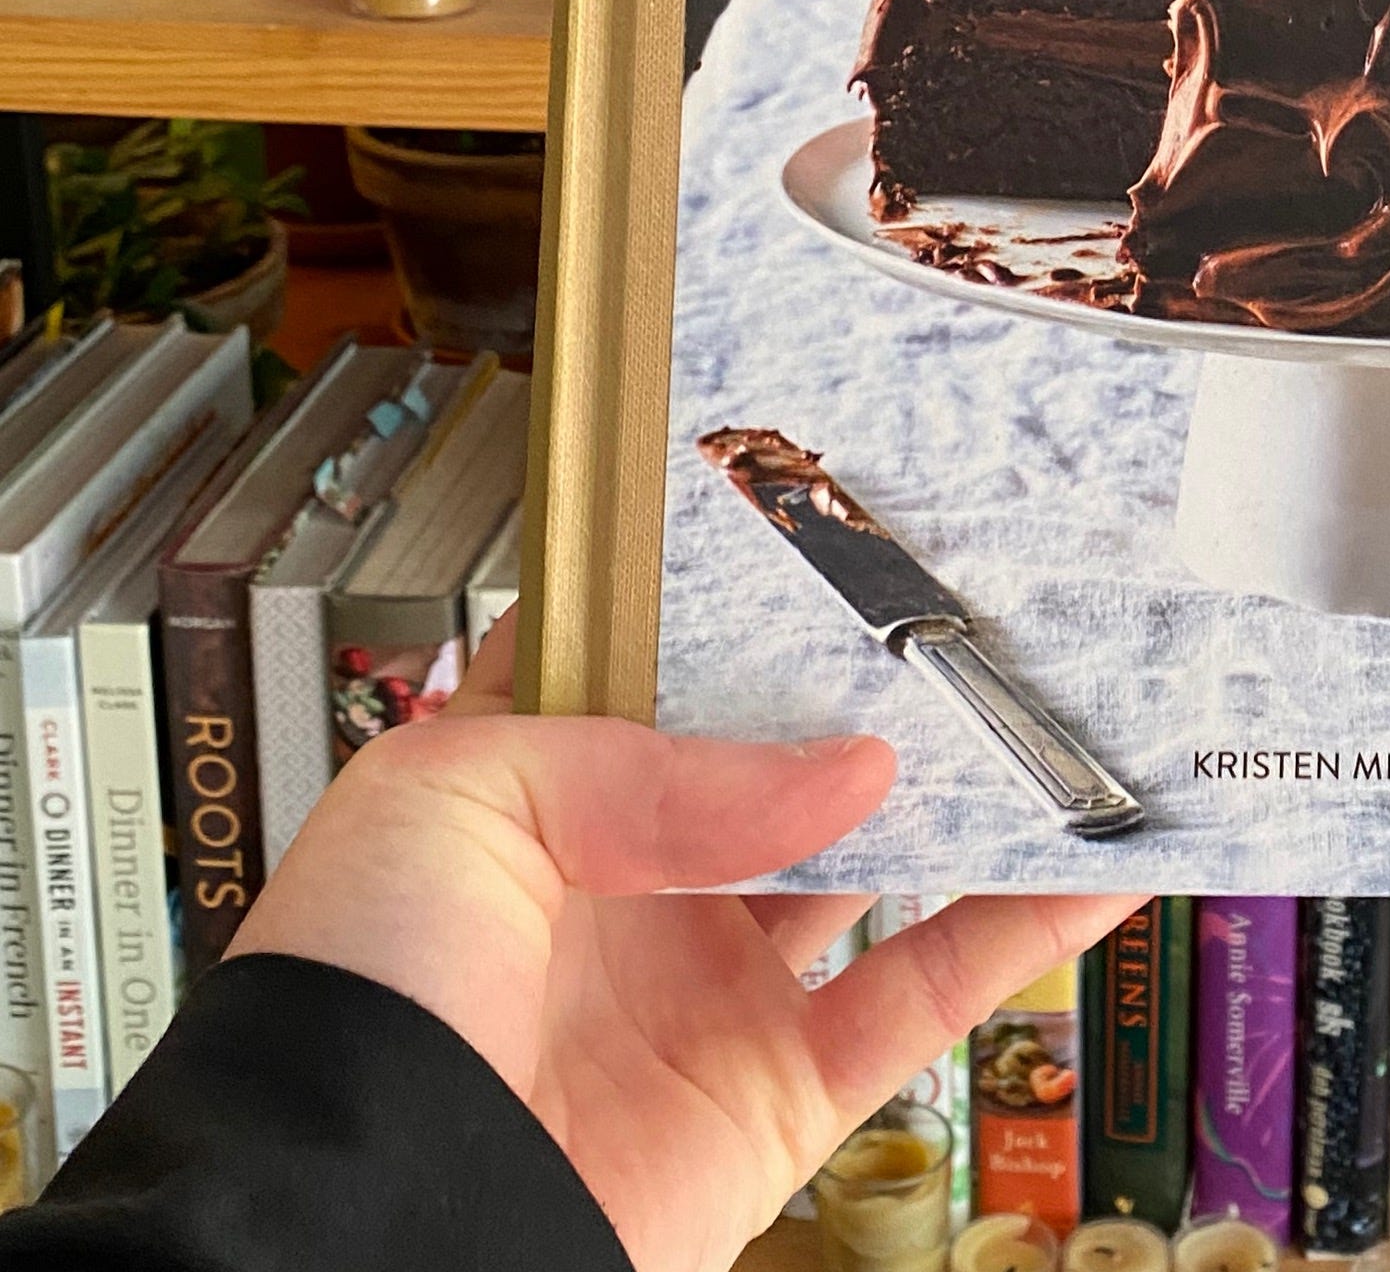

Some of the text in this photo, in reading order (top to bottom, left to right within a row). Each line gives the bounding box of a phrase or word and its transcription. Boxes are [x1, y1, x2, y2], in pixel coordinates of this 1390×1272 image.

[39, 720, 58, 781] CLARK
[1193, 750, 1341, 780] KRISTEN
[184, 714, 247, 910] ROOTS
[45, 828, 76, 912] DINNER
[3, 905, 41, 1020] French
[106, 786, 158, 1053] Dinner in One
[1226, 912, 1253, 984] Annie
[55, 980, 88, 1072] INSTANT
